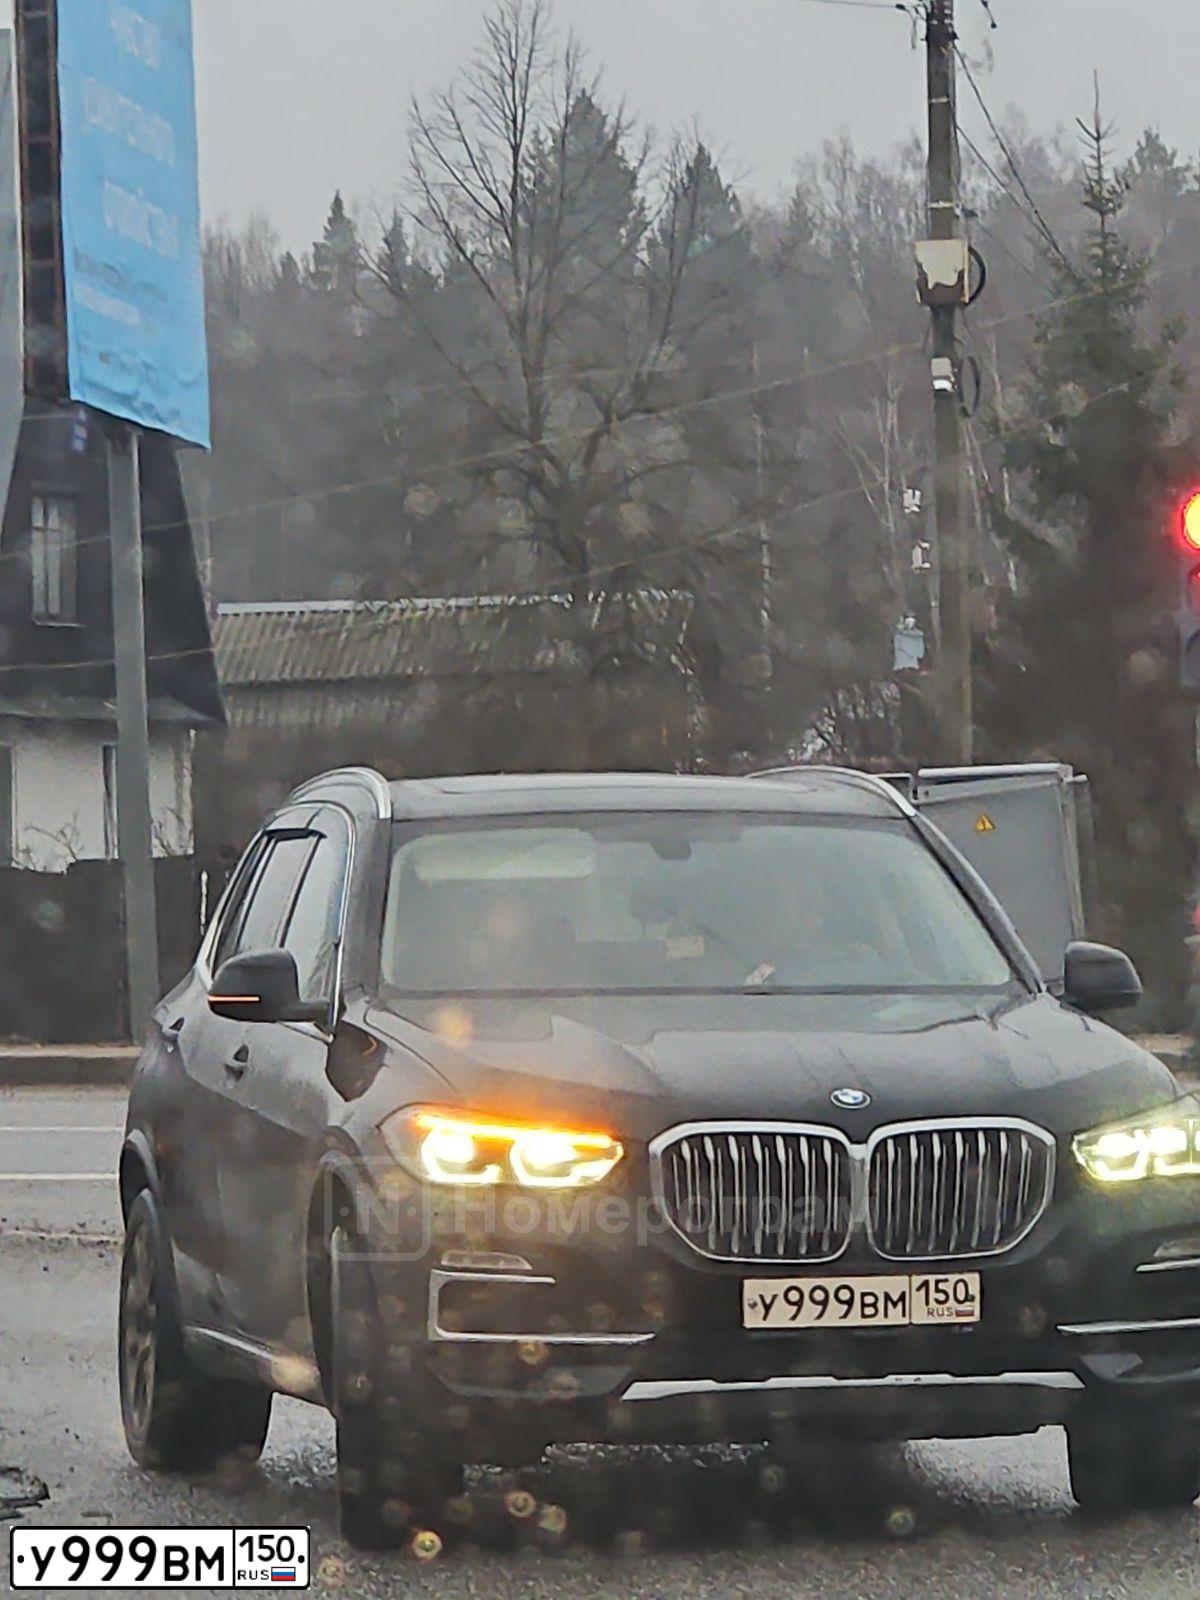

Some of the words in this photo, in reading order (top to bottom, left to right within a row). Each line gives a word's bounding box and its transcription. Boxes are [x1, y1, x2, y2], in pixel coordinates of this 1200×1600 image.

[758, 1284, 907, 1321] У999ВМ
[915, 1278, 970, 1306] 150
[927, 1307, 953, 1318] RUS
